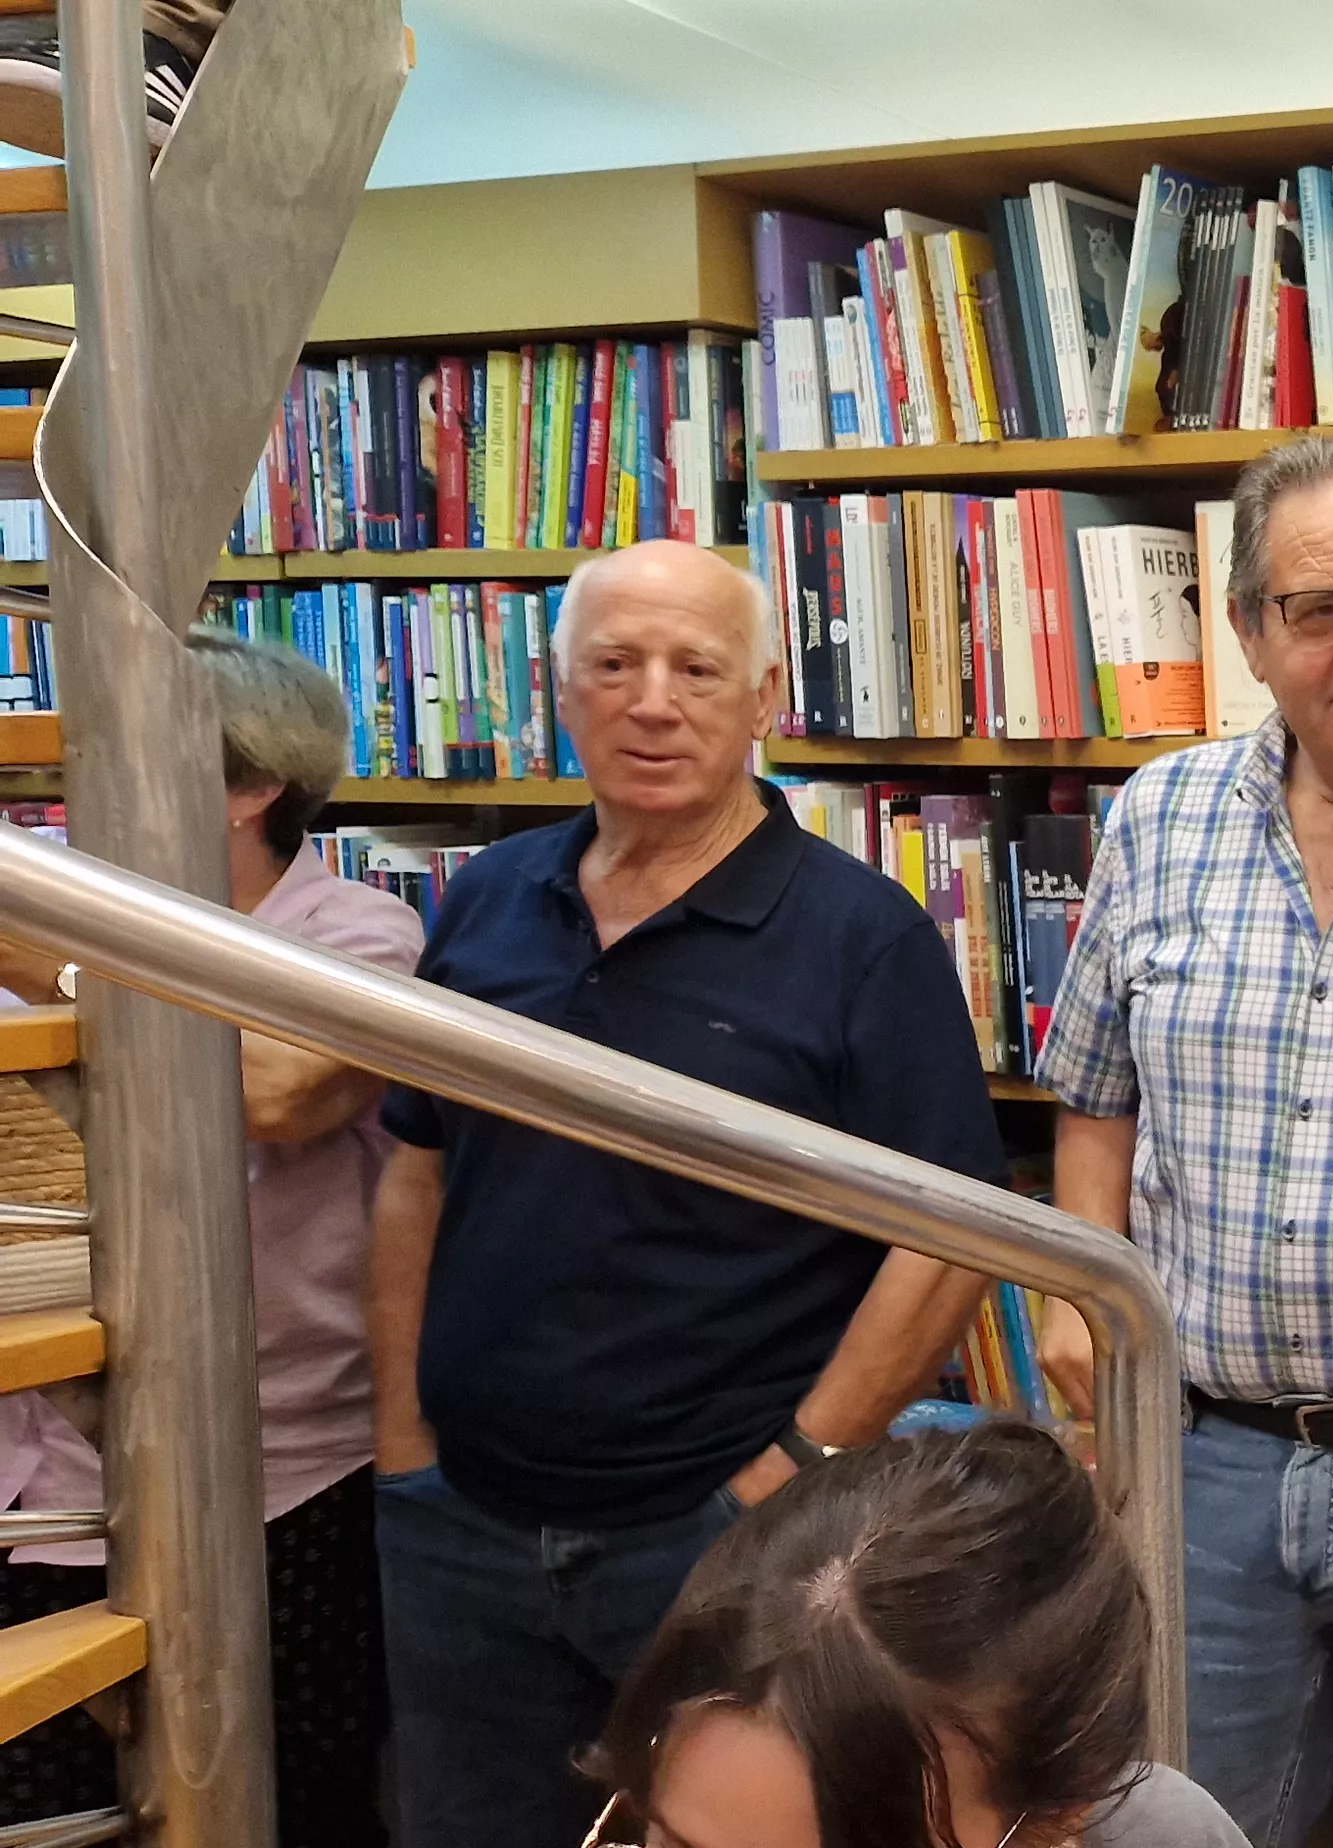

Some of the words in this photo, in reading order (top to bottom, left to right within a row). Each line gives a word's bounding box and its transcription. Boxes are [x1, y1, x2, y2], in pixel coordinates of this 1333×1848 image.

[1141, 547, 1200, 578] HIERB
[1008, 561, 1020, 599] ALICE
[1011, 599, 1022, 626] GUY
[961, 620, 974, 680] ROTUNDA
